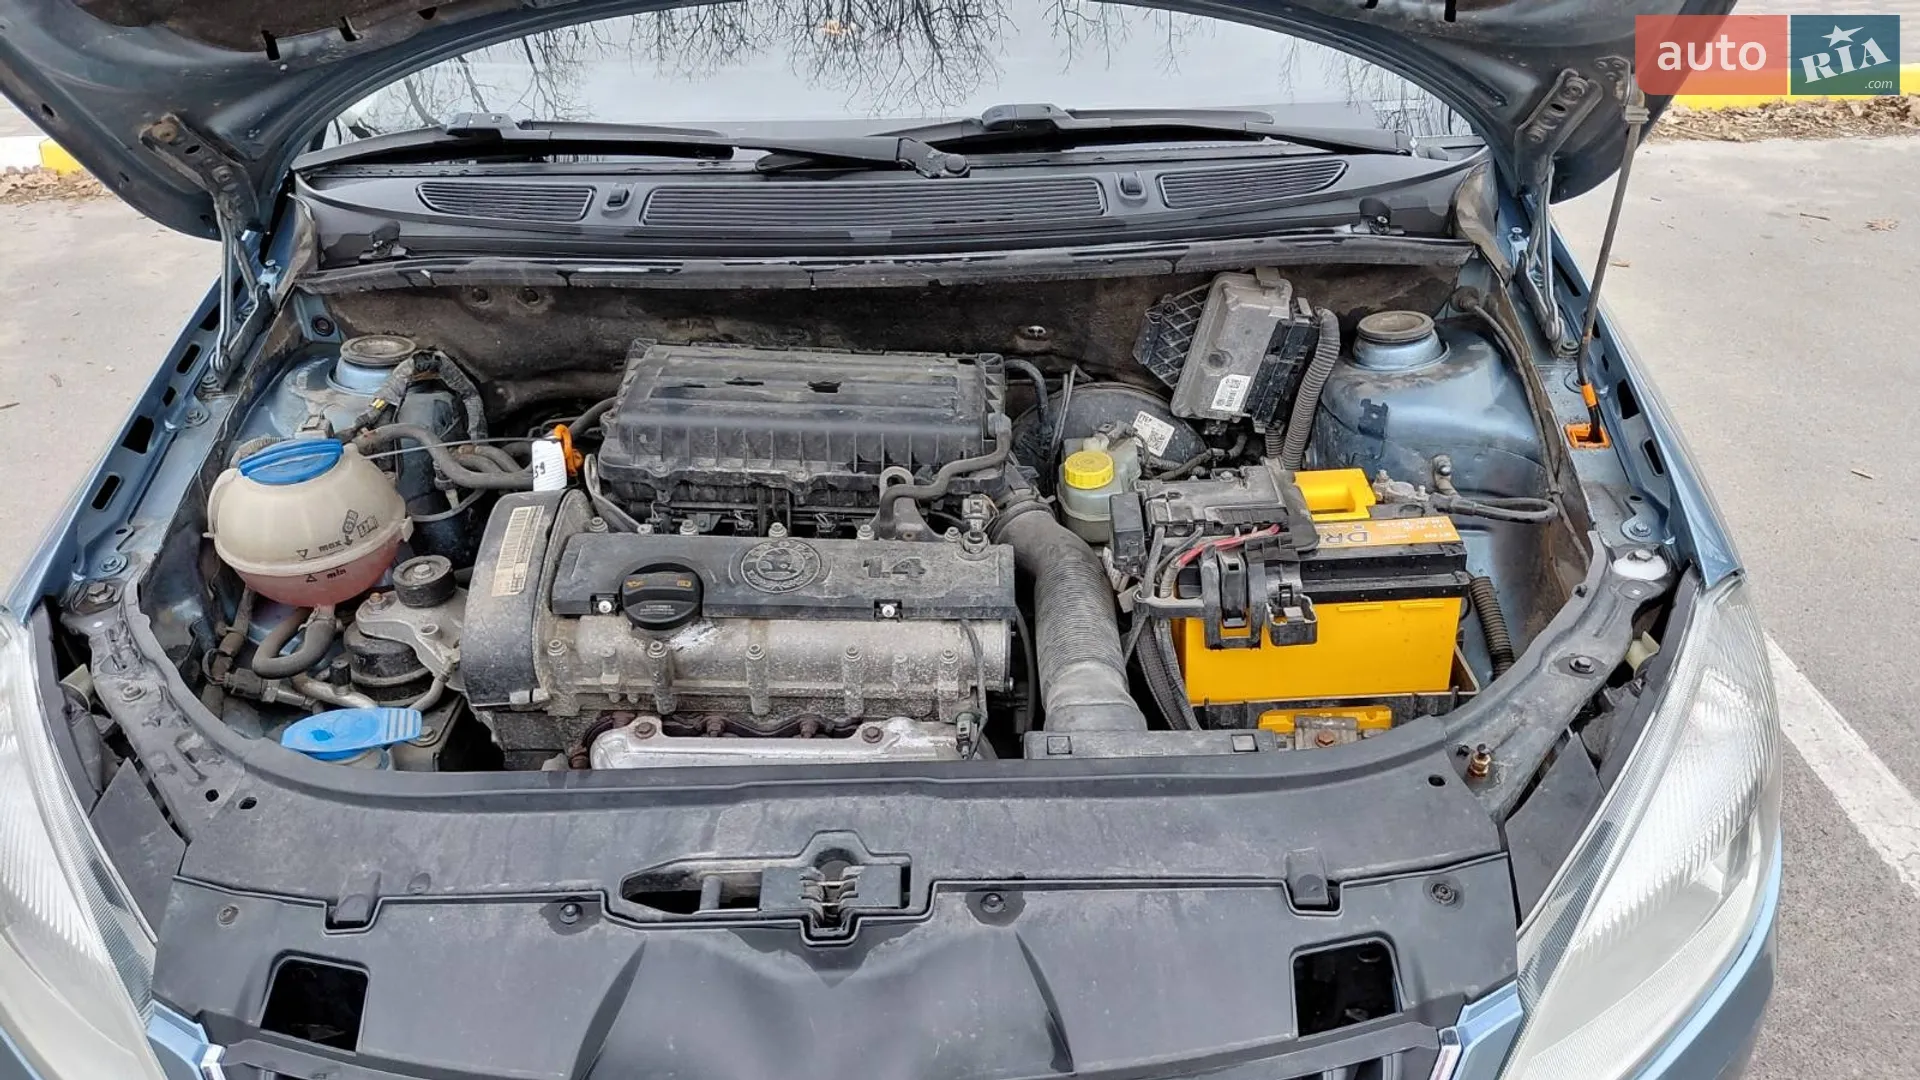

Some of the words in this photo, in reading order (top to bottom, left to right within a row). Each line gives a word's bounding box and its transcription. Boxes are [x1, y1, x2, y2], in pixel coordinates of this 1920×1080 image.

[1317, 531, 1367, 544] DR
[319, 540, 342, 552] max
[326, 568, 347, 579] min
[862, 556, 926, 579] 1.4
